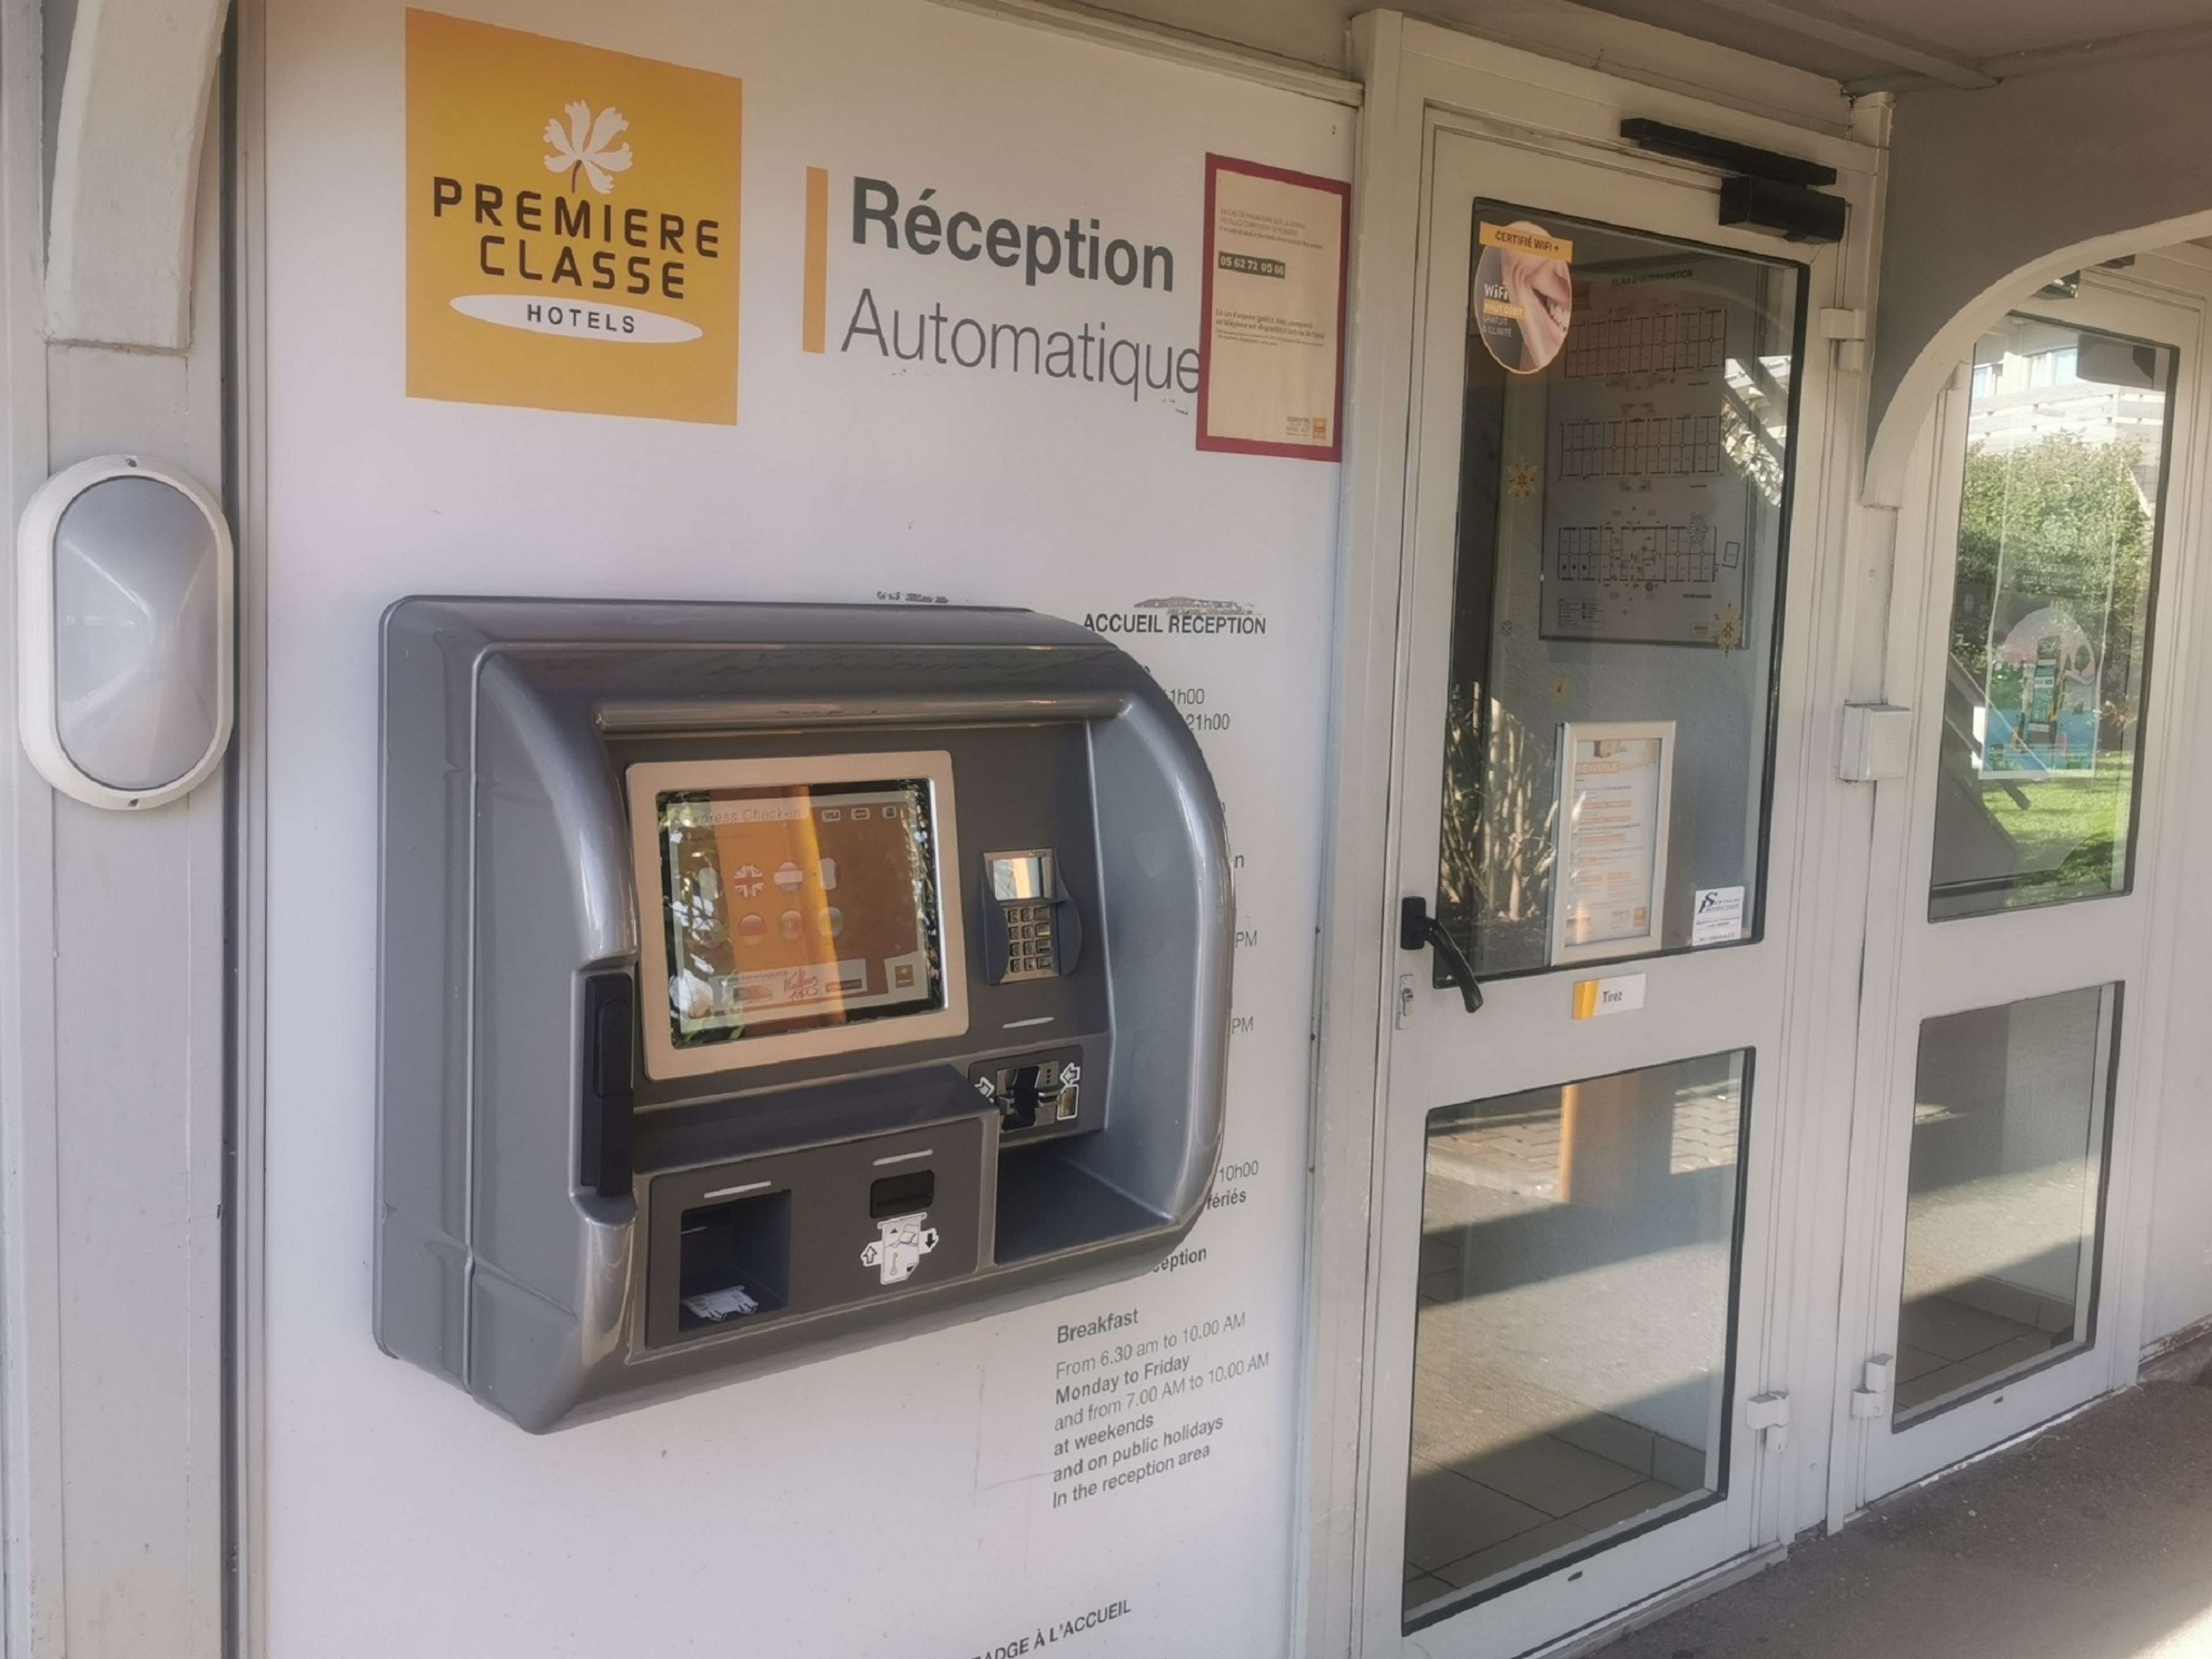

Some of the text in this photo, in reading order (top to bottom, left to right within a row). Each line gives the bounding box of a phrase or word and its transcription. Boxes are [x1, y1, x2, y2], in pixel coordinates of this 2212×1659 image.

[434, 176, 719, 258] PREMIERE
[853, 176, 1174, 292] Réception
[480, 235, 684, 300] CLASSE
[1221, 255, 1232, 267] 05
[1234, 257, 1245, 268] 62
[528, 304, 634, 334] HOTELS
[841, 288, 1200, 402] Automatique
[1084, 613, 1163, 632] ACCUEIL
[1164, 688, 1205, 704] 1h00
[1186, 713, 1230, 730] 21h00
[689, 809, 737, 825] xpress
[824, 811, 839, 819] VISA
[1235, 930, 1257, 948] PM
[1603, 990, 1623, 1004] Tirez
[1232, 1016, 1253, 1035] PM
[1219, 1160, 1259, 1183] 10h00
[1207, 1188, 1246, 1210] fériés
[1057, 1308, 1138, 1343] Breakfast
[1056, 1312, 1245, 1379] From 6.30 am to 10.00 AM
[1054, 1351, 1269, 1431] and from 7.00 AM to 10.00 AM
[1056, 1355, 1190, 1404] Monday to Friday
[1053, 1416, 1224, 1482] and on public holidays
[1054, 1414, 1154, 1456] at weekends
[1053, 1445, 1210, 1508] In the reception area
[972, 1599, 1132, 1659] ADGE À L'ACCUEIL
